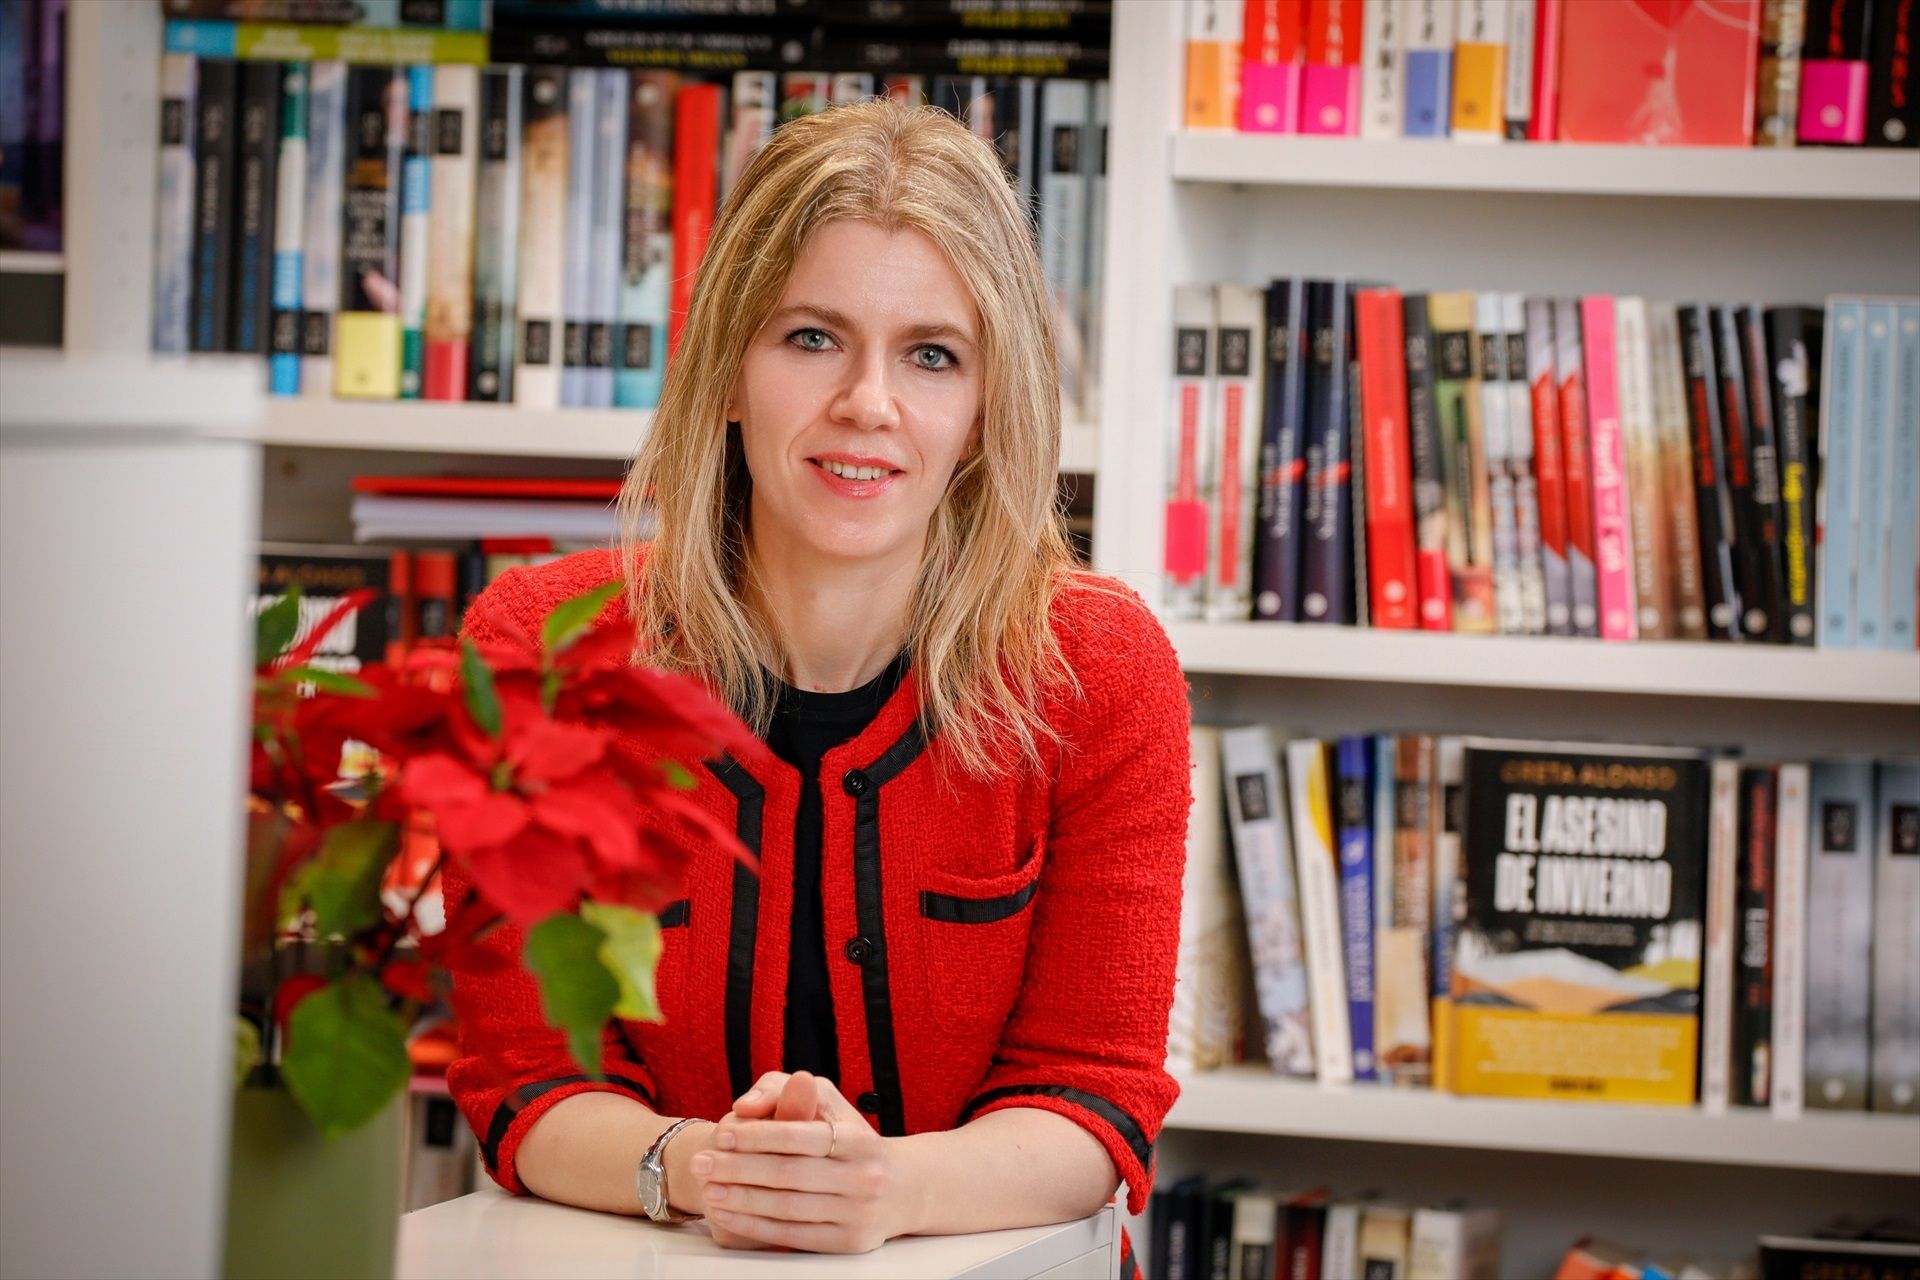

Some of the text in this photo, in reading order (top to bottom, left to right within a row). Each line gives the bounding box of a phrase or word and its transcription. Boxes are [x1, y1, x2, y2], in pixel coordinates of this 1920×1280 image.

[1580, 764, 1676, 790] ALONSO
[1504, 792, 1666, 858] EL ASESINO
[1493, 851, 1537, 913] DE
[1536, 855, 1672, 919] INVIERNO
